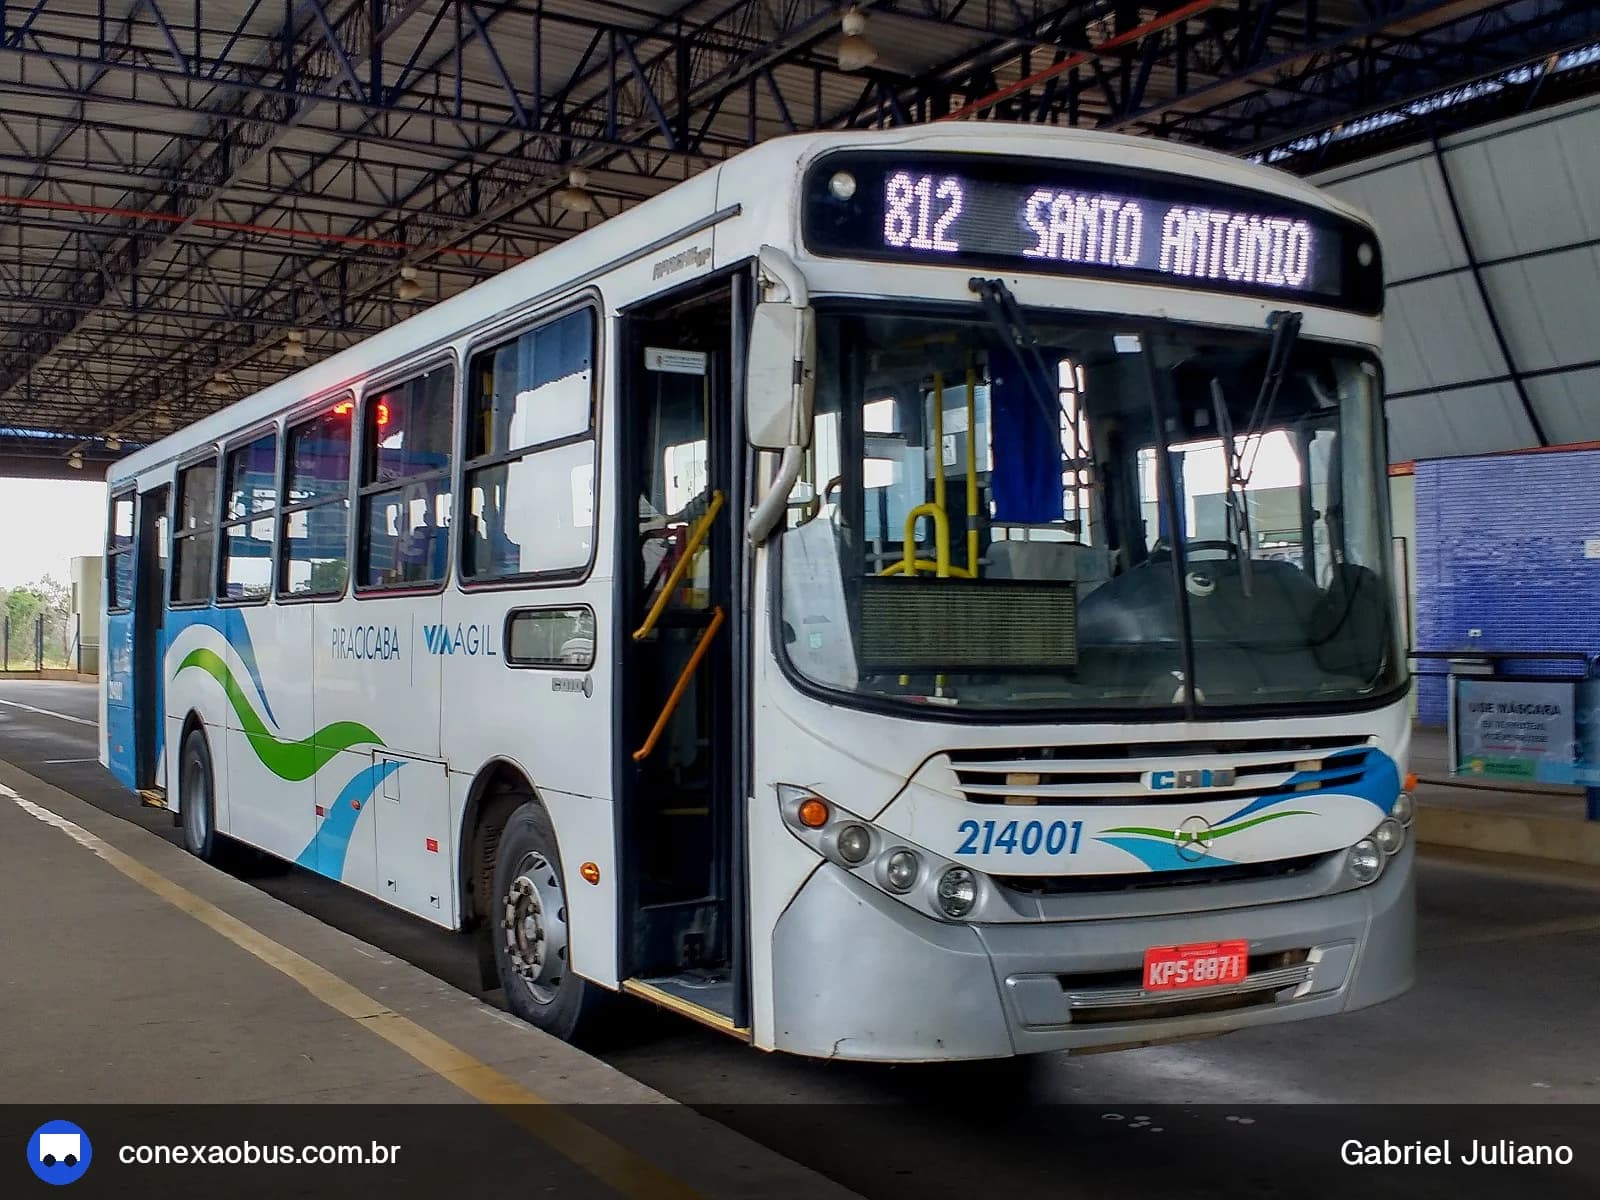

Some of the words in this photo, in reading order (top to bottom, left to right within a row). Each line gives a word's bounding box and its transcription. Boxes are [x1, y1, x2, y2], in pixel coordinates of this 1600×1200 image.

[884, 171, 963, 252] 812
[1023, 188, 1142, 267] SANTO
[1159, 207, 1310, 287] ANTONIO
[332, 625, 401, 660] PIRACICABA
[954, 820, 1083, 855] 214001
[1149, 955, 1241, 985] KPS-8871
